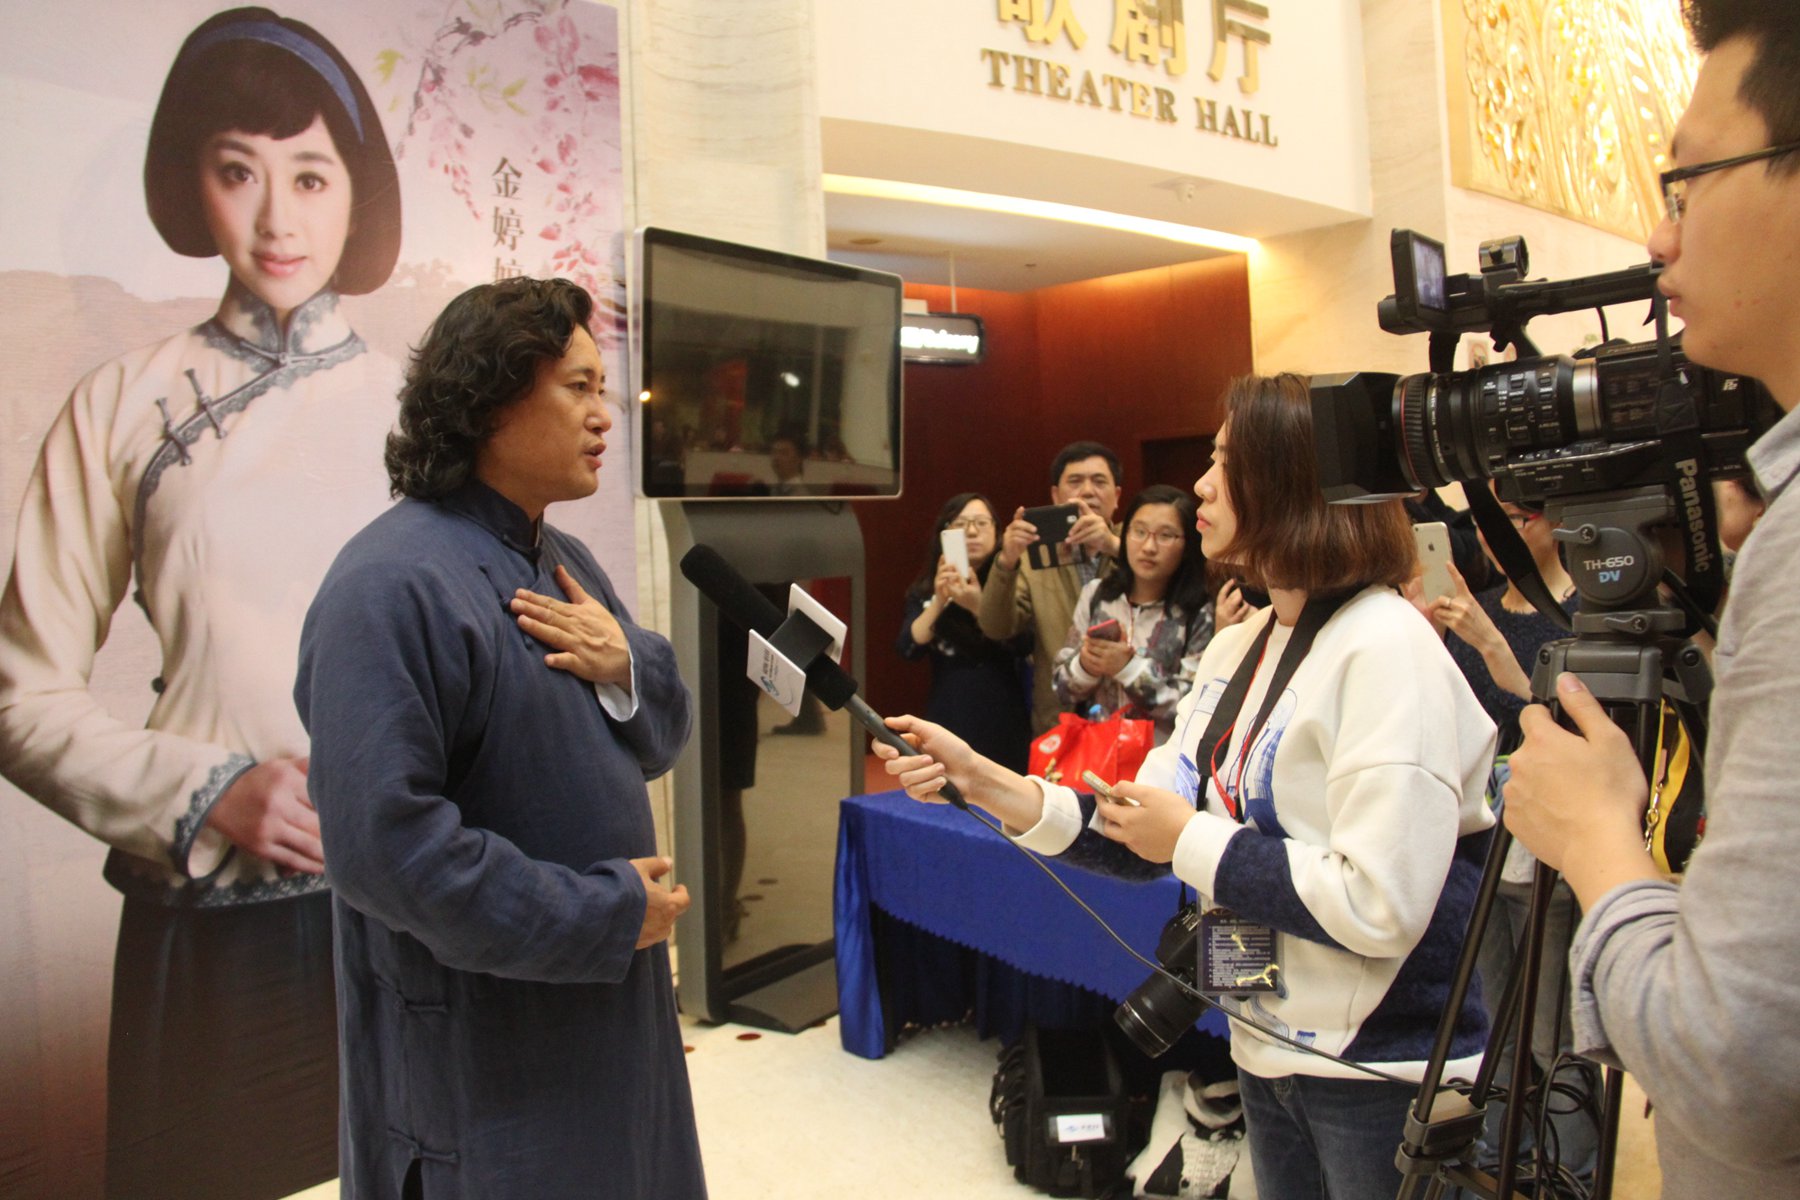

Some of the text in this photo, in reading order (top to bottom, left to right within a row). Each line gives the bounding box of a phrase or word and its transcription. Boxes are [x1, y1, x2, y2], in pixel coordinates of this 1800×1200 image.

[981, 48, 1278, 147] THEATER HALL
[1675, 458, 1714, 573] Panasonic
[1583, 555, 1635, 571] TH-650
[1599, 570, 1621, 583] DV
